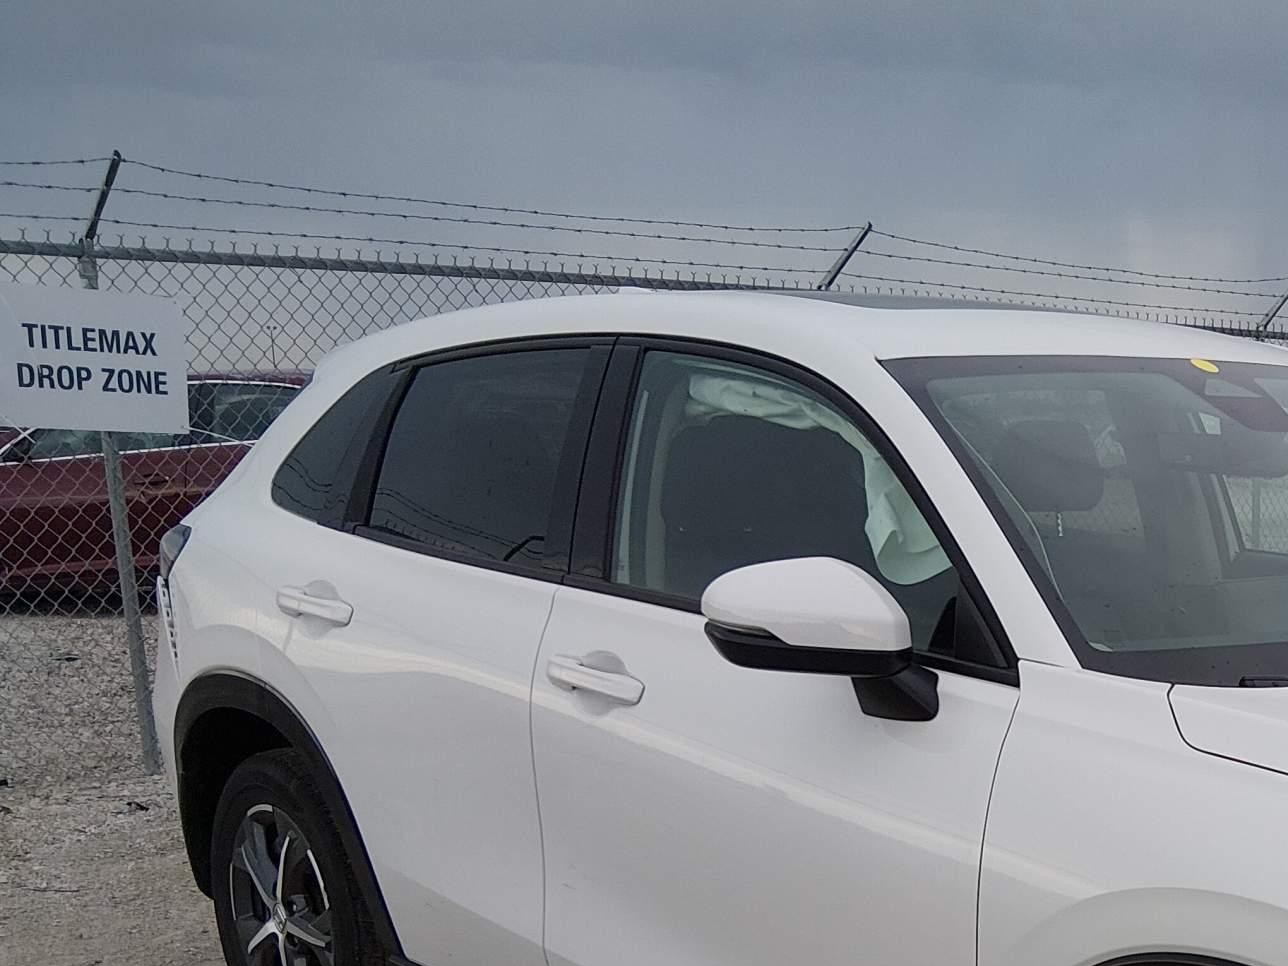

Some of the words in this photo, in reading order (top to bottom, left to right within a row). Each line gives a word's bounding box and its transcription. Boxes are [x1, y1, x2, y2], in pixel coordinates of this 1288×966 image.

[21, 322, 158, 357] TITLEMAX
[16, 362, 92, 391] DROP
[100, 367, 169, 396] ZONE
